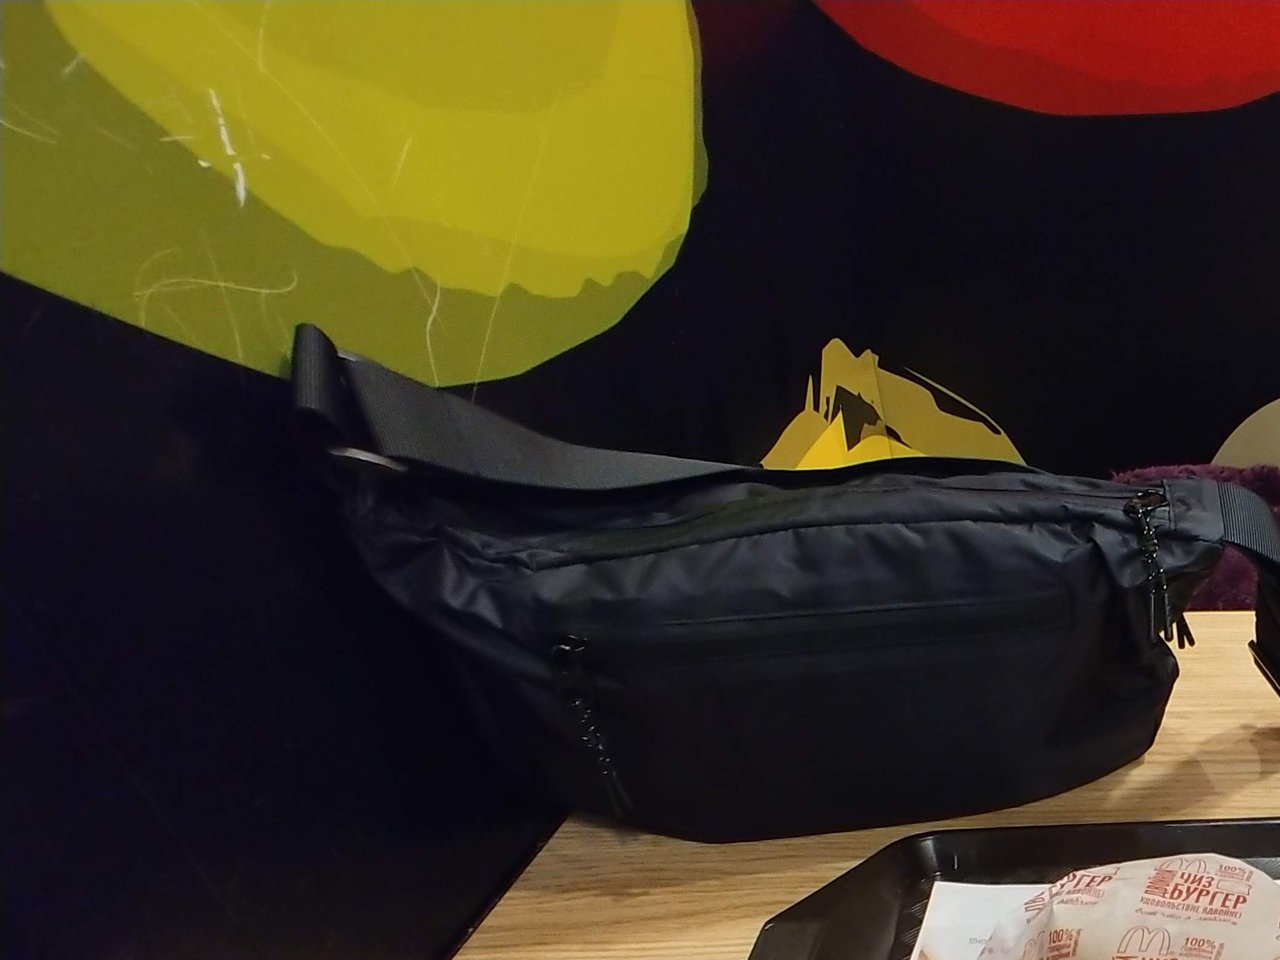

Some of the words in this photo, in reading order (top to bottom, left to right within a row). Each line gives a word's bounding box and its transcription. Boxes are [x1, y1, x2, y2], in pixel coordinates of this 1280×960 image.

[1179, 871, 1215, 888] ЧИЗ
[1168, 883, 1247, 909] БУРГЕР
[1049, 928, 1074, 945] 100%
[1185, 937, 1216, 949] 100%
